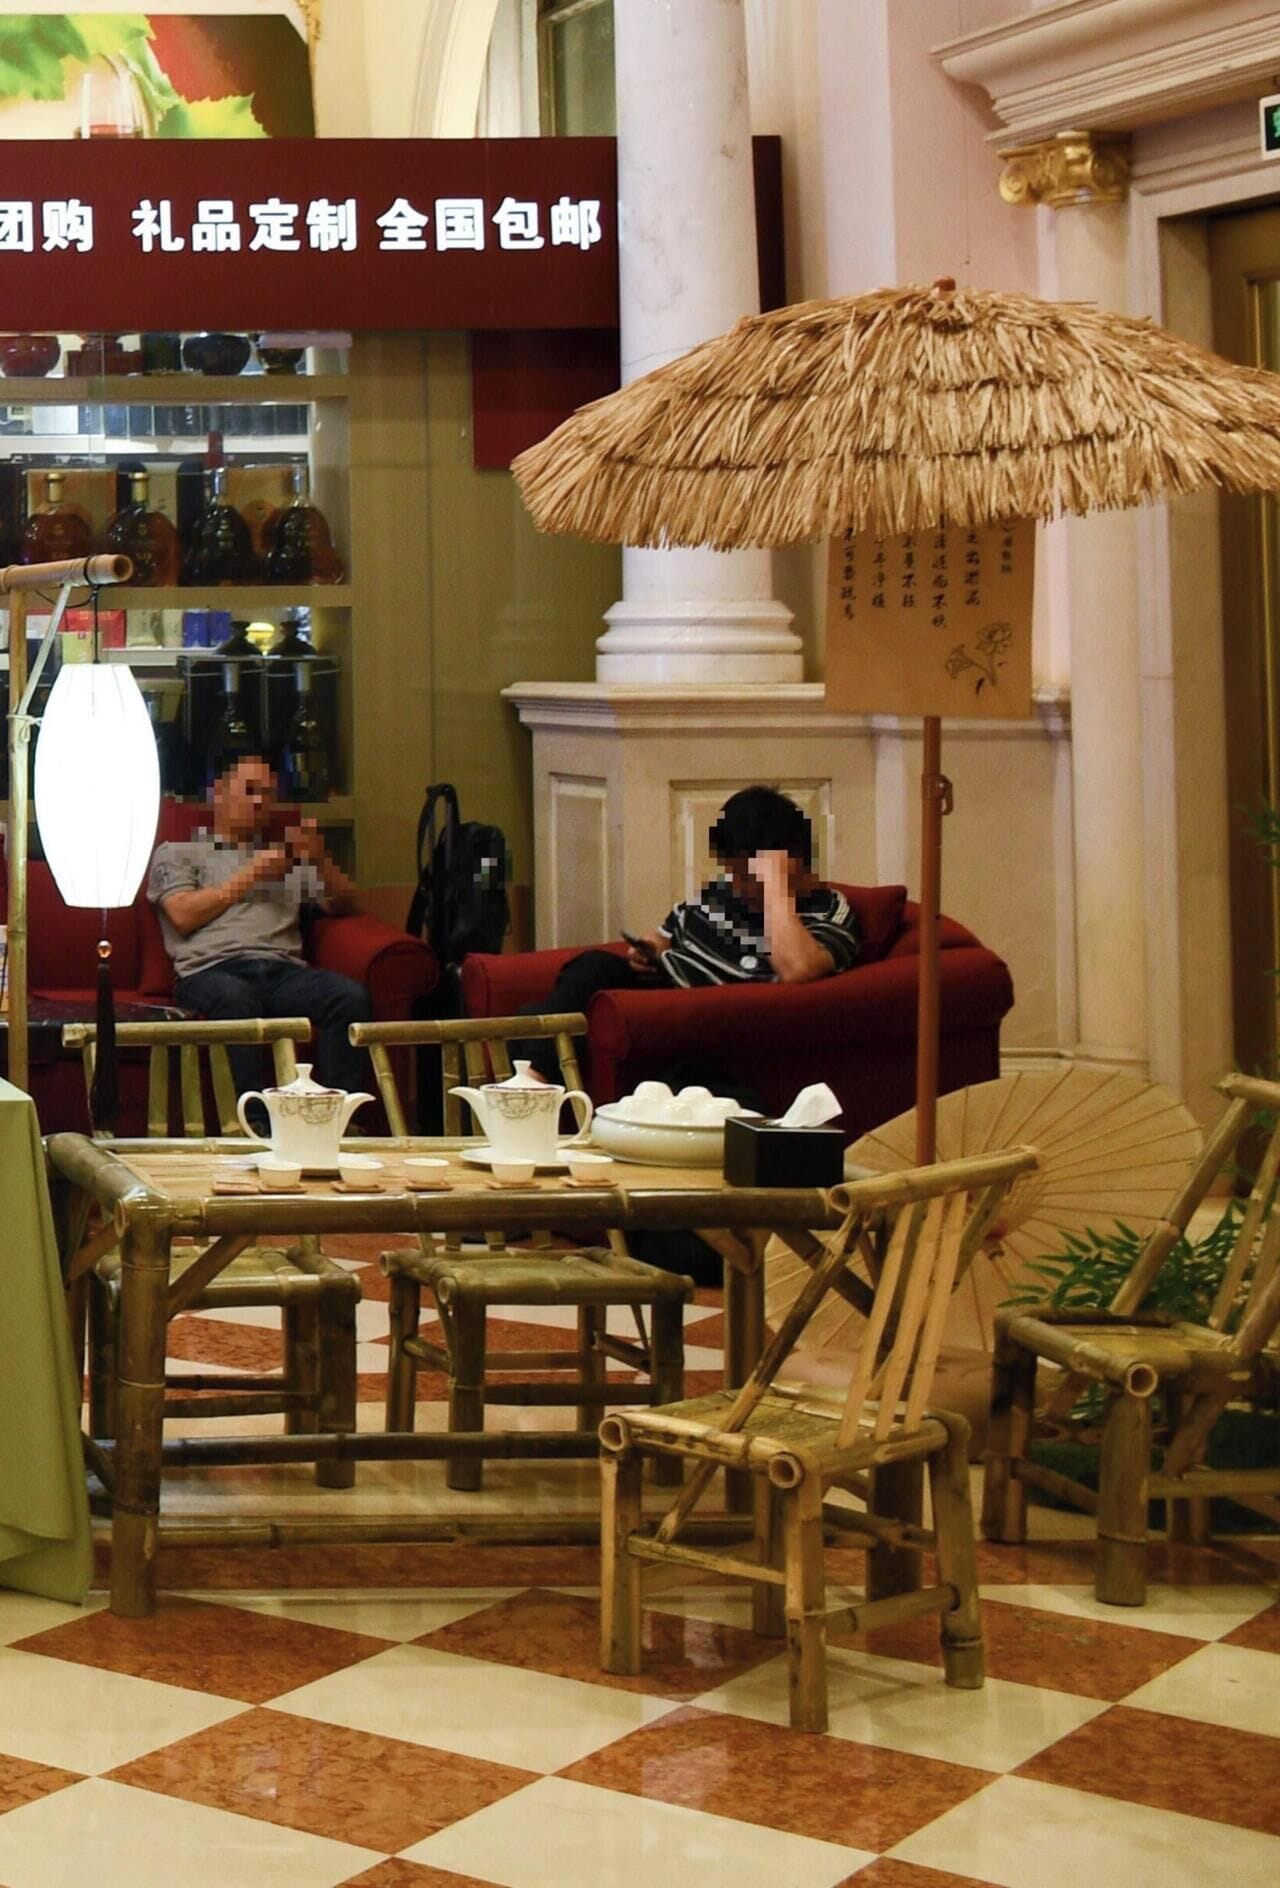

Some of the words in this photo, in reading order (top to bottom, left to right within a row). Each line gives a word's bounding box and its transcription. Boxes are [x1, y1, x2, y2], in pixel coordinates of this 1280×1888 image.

[132, 198, 358, 252] 礼品定制
[375, 197, 602, 251] 全国包邮
